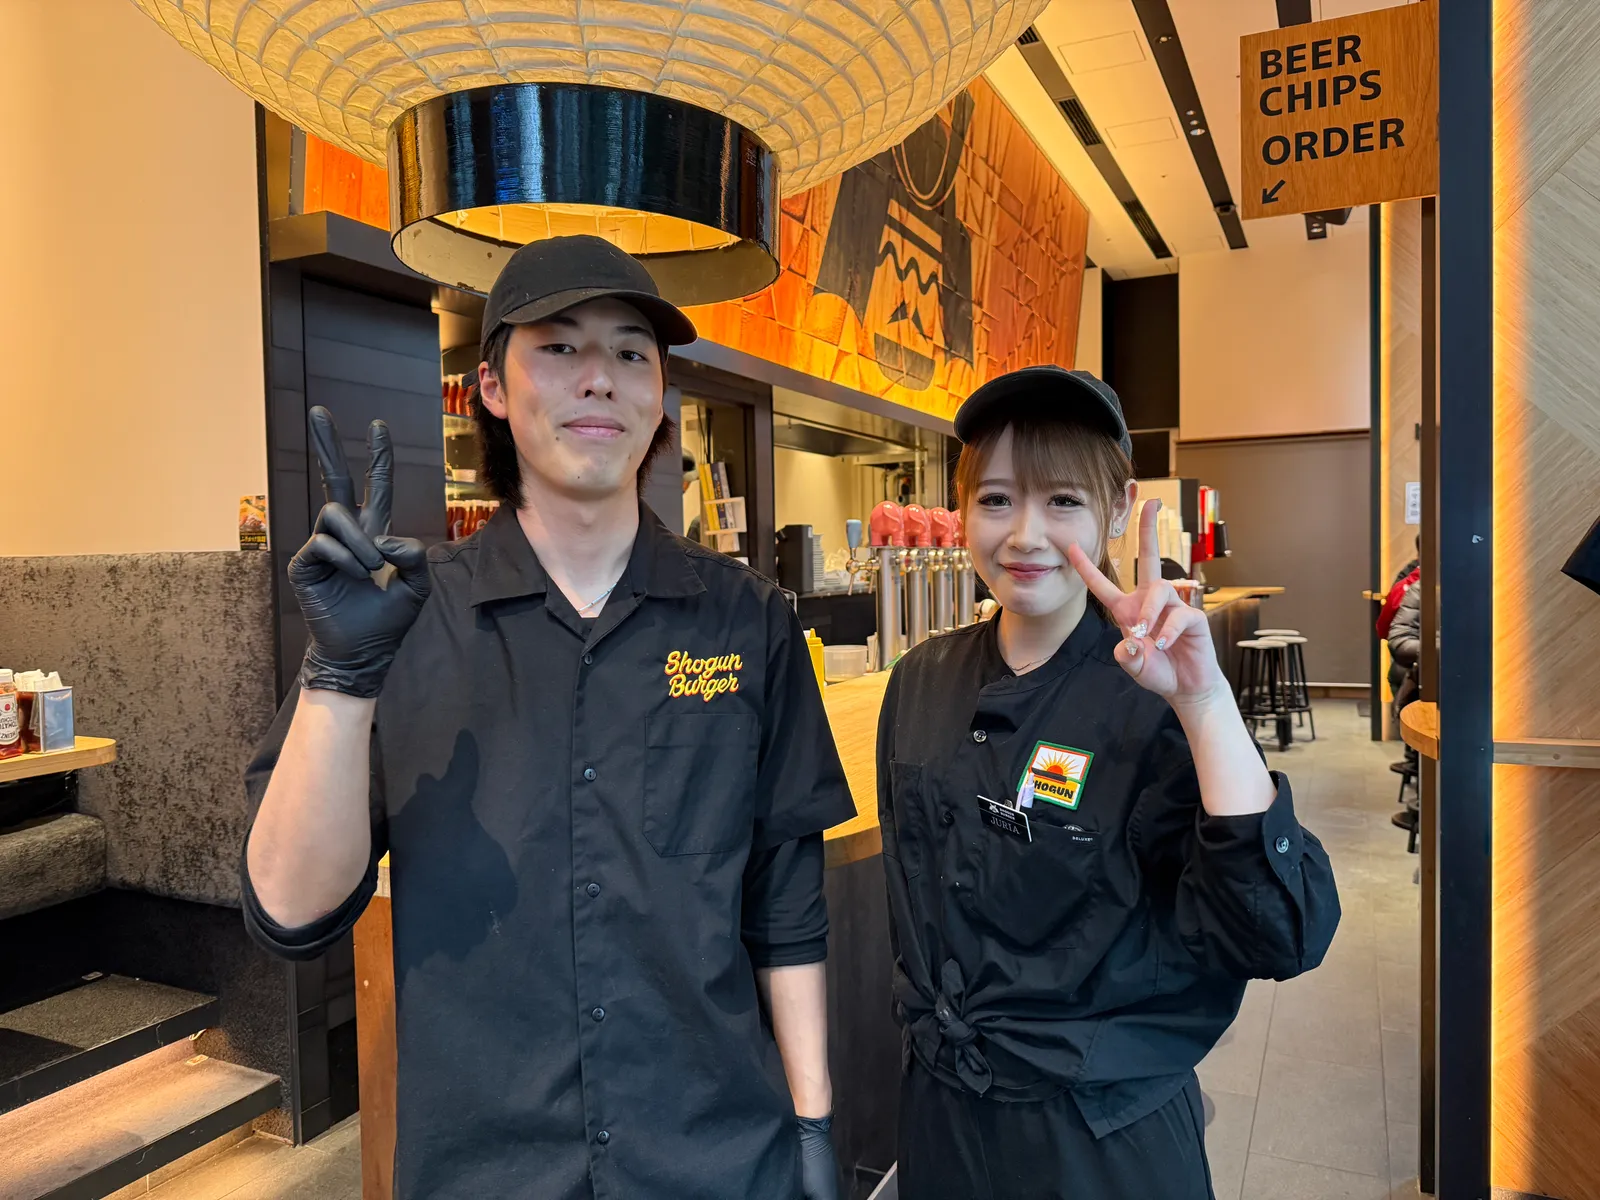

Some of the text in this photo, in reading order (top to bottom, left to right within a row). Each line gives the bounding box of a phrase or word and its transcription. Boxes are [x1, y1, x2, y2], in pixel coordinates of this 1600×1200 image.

[1260, 34, 1362, 80] BEER
[1259, 69, 1382, 117] CHIPS
[1261, 117, 1405, 166] ORDER
[664, 650, 743, 680] Shogun
[668, 672, 739, 703] Burger
[1032, 779, 1074, 800] HOGUN
[990, 816, 1020, 835] JURIA
